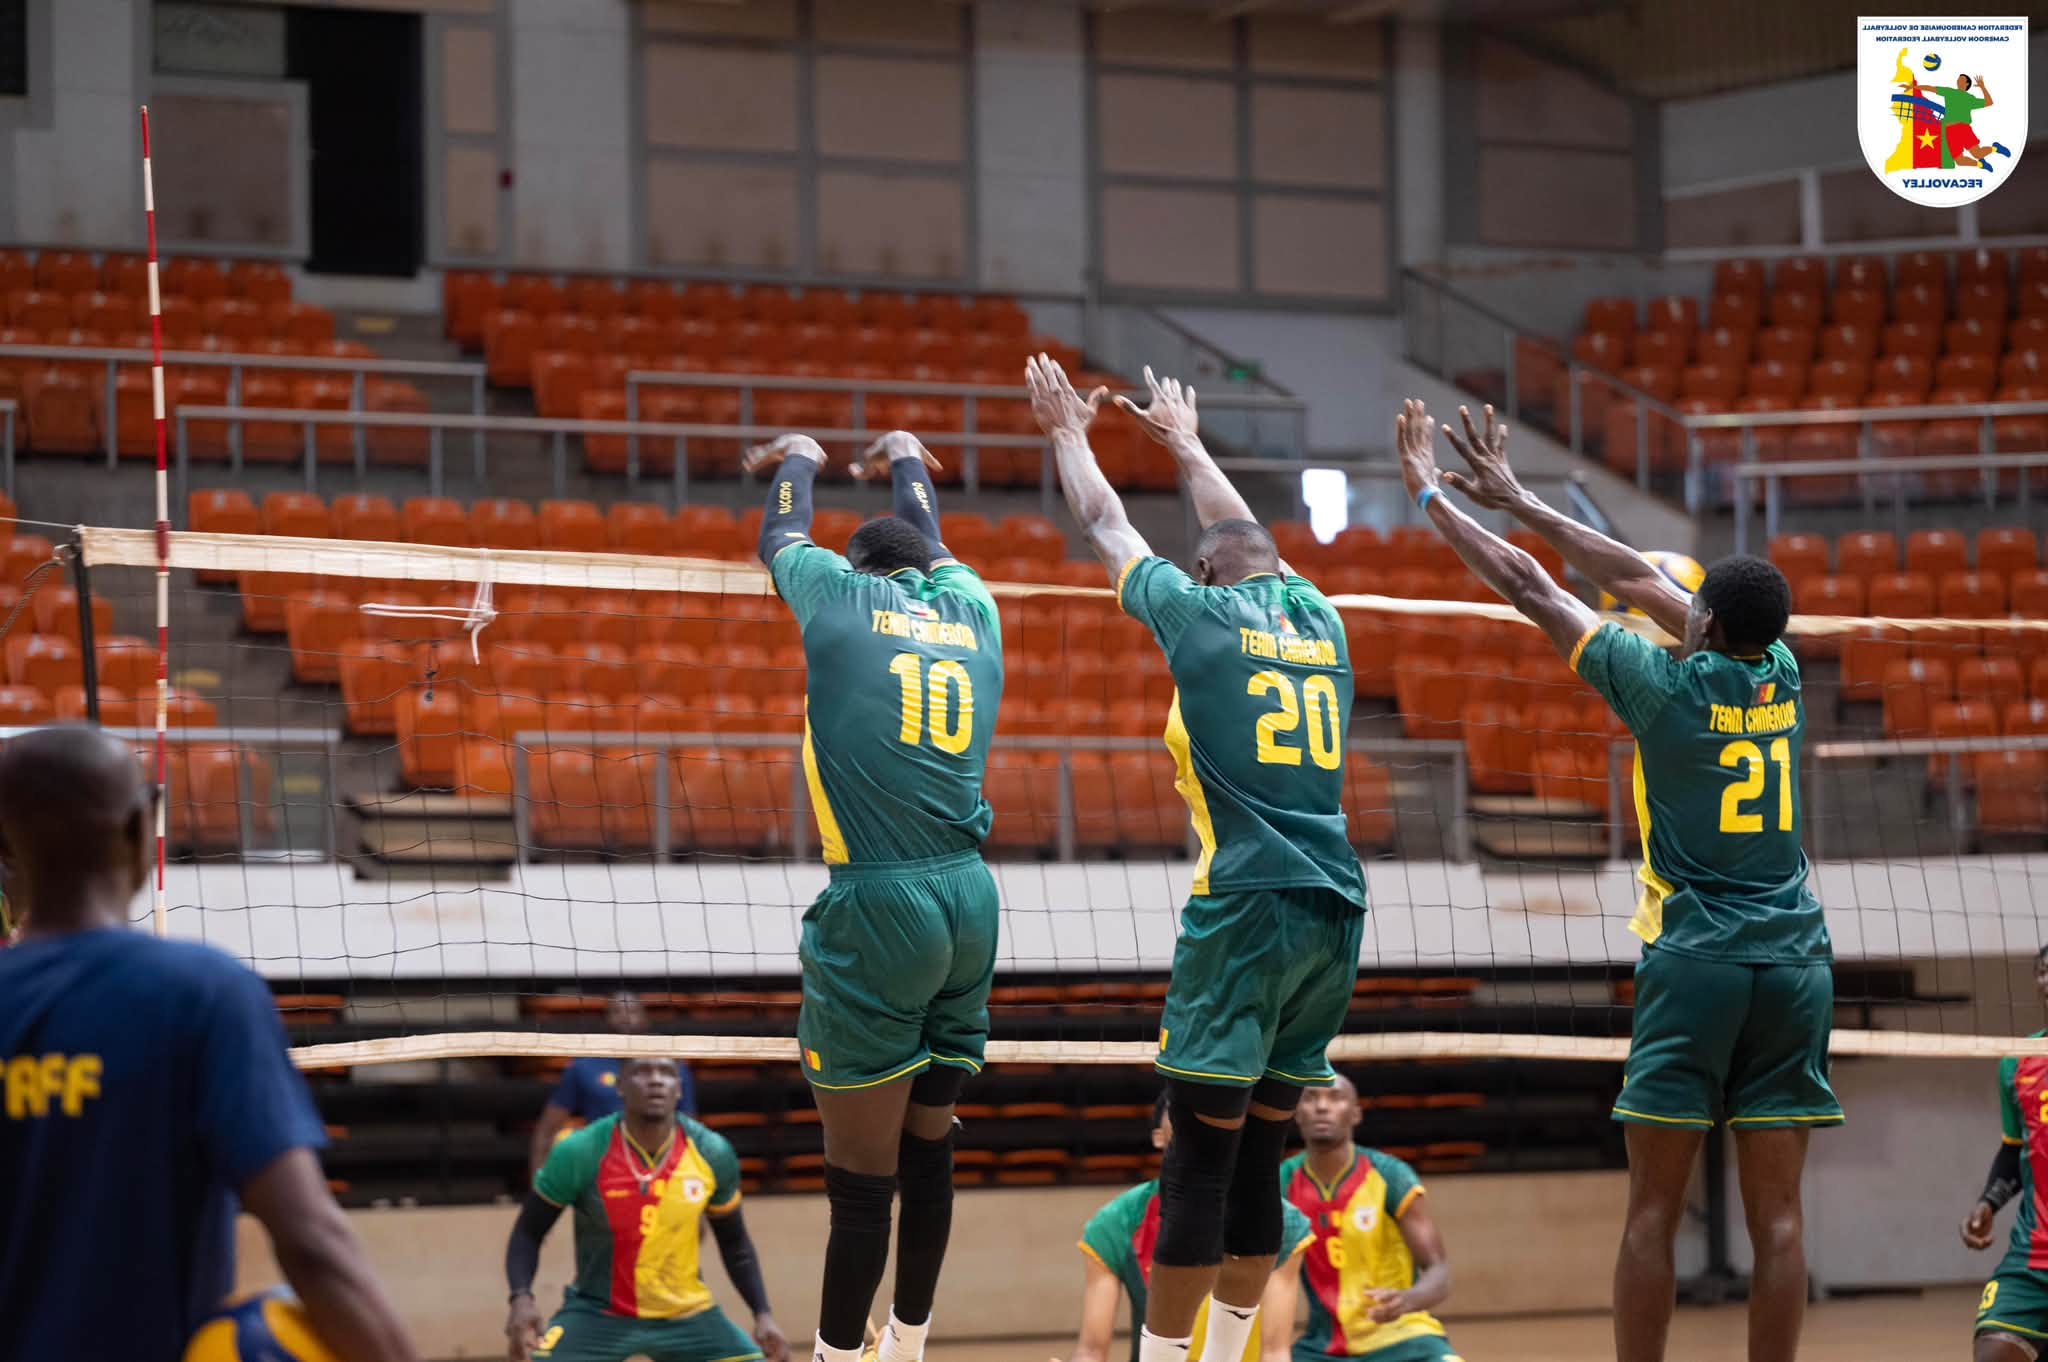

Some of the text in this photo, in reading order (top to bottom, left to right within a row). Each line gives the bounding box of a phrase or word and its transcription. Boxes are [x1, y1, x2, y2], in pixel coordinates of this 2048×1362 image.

[1239, 626, 1278, 659] TEAM
[889, 652, 975, 755] 10
[1247, 670, 1341, 771] 20
[1709, 703, 1743, 734] TEAM
[1719, 737, 1794, 833] 21
[0, 1052, 104, 1119] AFF
[639, 1204, 659, 1237] 9
[1326, 1235, 1346, 1269] 6
